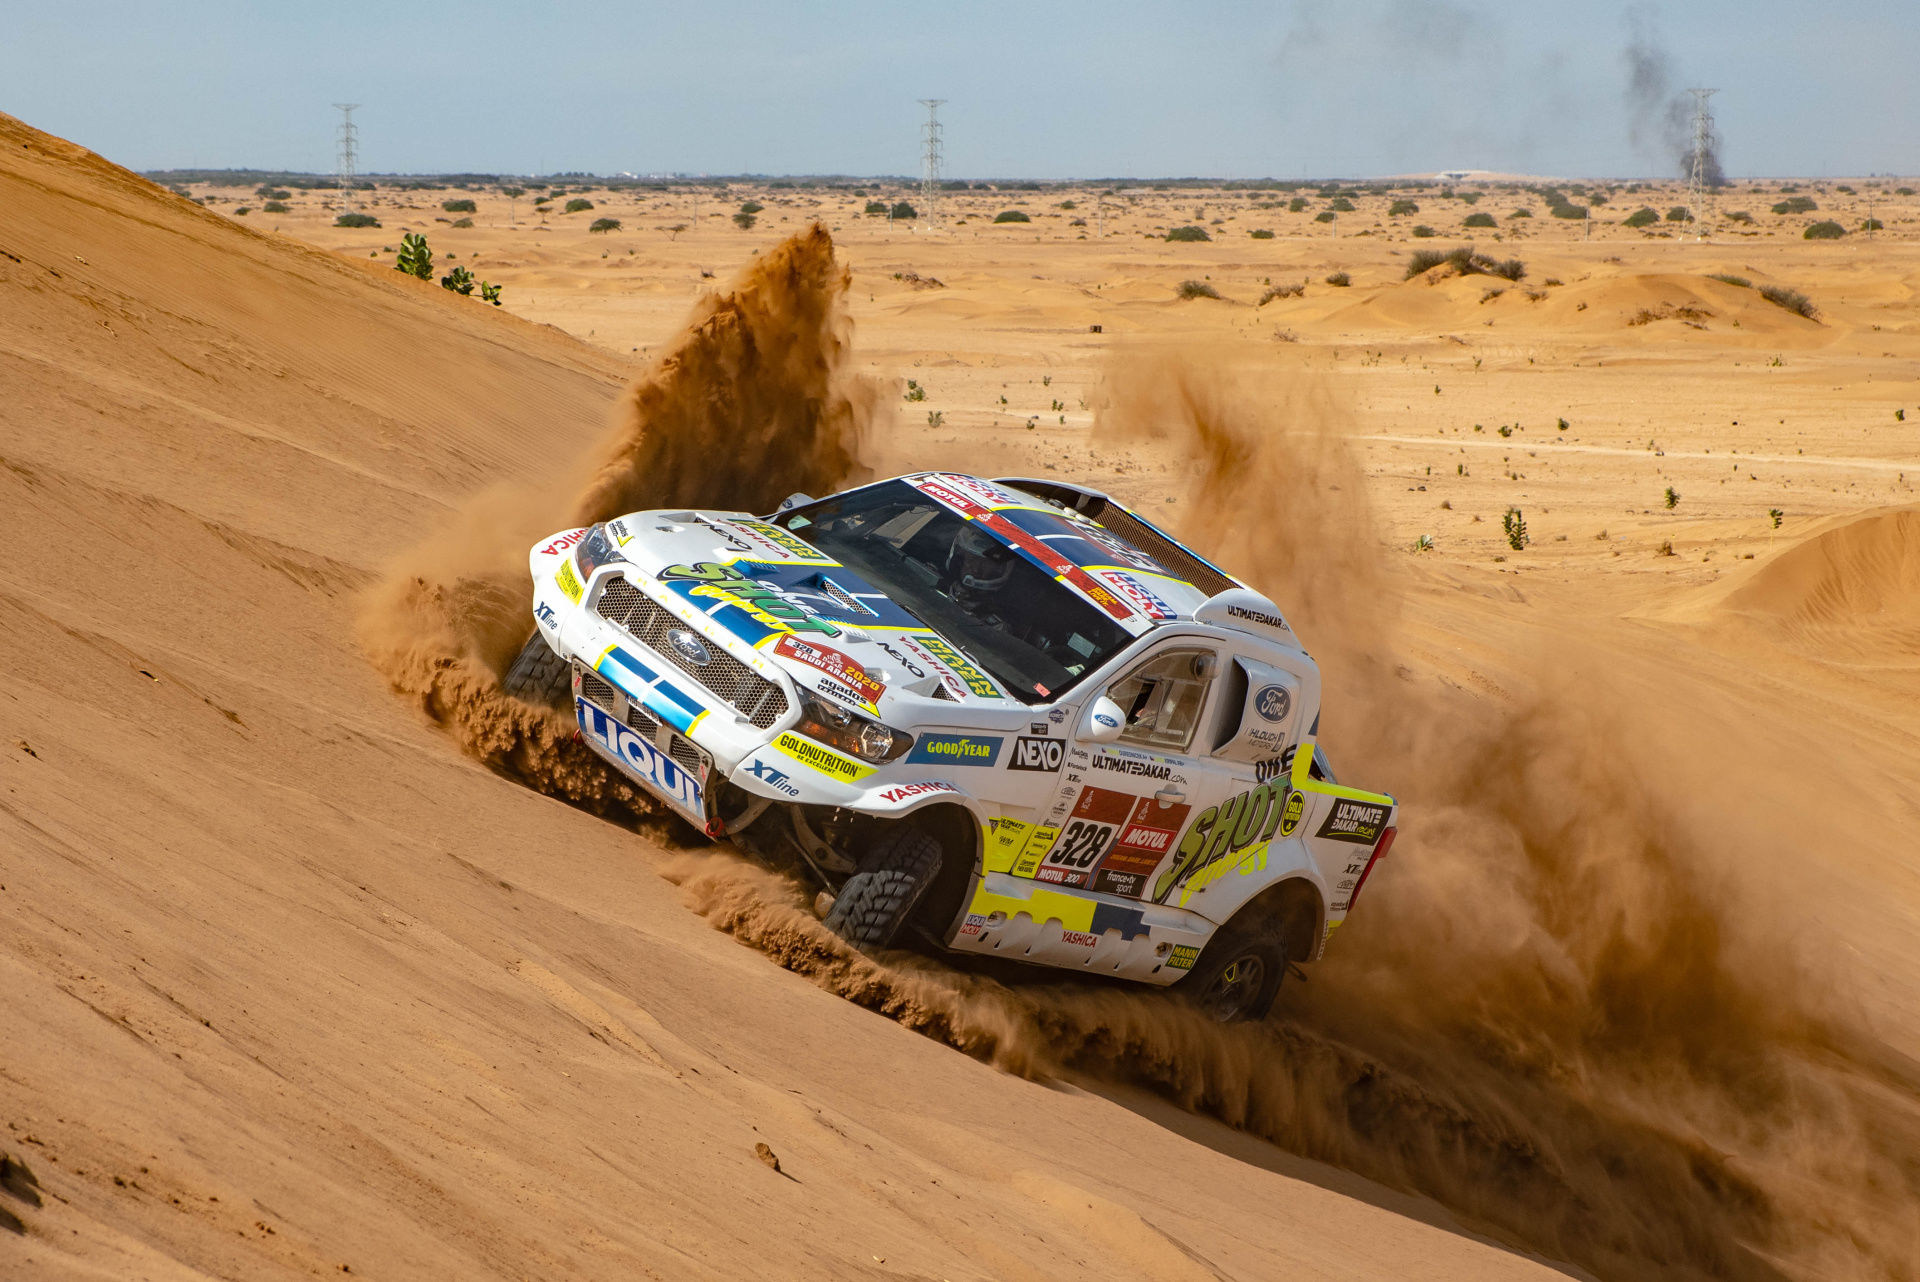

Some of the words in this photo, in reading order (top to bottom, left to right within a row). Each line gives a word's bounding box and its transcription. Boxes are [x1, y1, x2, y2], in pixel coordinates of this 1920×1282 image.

[924, 485, 969, 508] MOTUL
[656, 561, 840, 638] SHOT
[756, 580, 821, 615] ONE
[1101, 573, 1166, 620] MOLY
[1114, 572, 1178, 617] LIQUI
[533, 601, 558, 631] XTline
[792, 641, 813, 655] 328
[876, 641, 926, 679] NEXO
[793, 650, 826, 668] SAUDI
[826, 666, 863, 690] ARABIA
[844, 665, 880, 691] 2020
[898, 635, 968, 698] YASHICA
[918, 639, 987, 697] FILTER
[930, 638, 999, 697] MANN
[819, 677, 868, 705] agados
[1261, 689, 1286, 717] Ford
[1099, 715, 1115, 727] Ford
[583, 703, 700, 816] LIQUI
[780, 734, 857, 778] GOLDNUTRITION
[927, 738, 991, 758] GOODYEAR
[1016, 739, 1062, 771] NEXO
[805, 758, 837, 775] EXCELLENT
[1256, 743, 1297, 783] ONE
[743, 758, 800, 798] XTline
[880, 779, 961, 803] YASHICA
[1331, 818, 1358, 833] DAKAR
[1336, 803, 1383, 824] ULTIMATE
[1050, 821, 1113, 869] 328
[1124, 828, 1170, 849] MOTUL
[1152, 771, 1293, 904] SHOT
[1038, 868, 1065, 882] MOTUL
[1063, 873, 1080, 884] 300
[1115, 883, 1133, 894] sport
[960, 924, 982, 935] MOLY
[967, 913, 986, 926] LIQUI
[1061, 930, 1098, 948] YASHICA
[1172, 945, 1199, 959] MANN
[1166, 956, 1194, 969] FILTER
